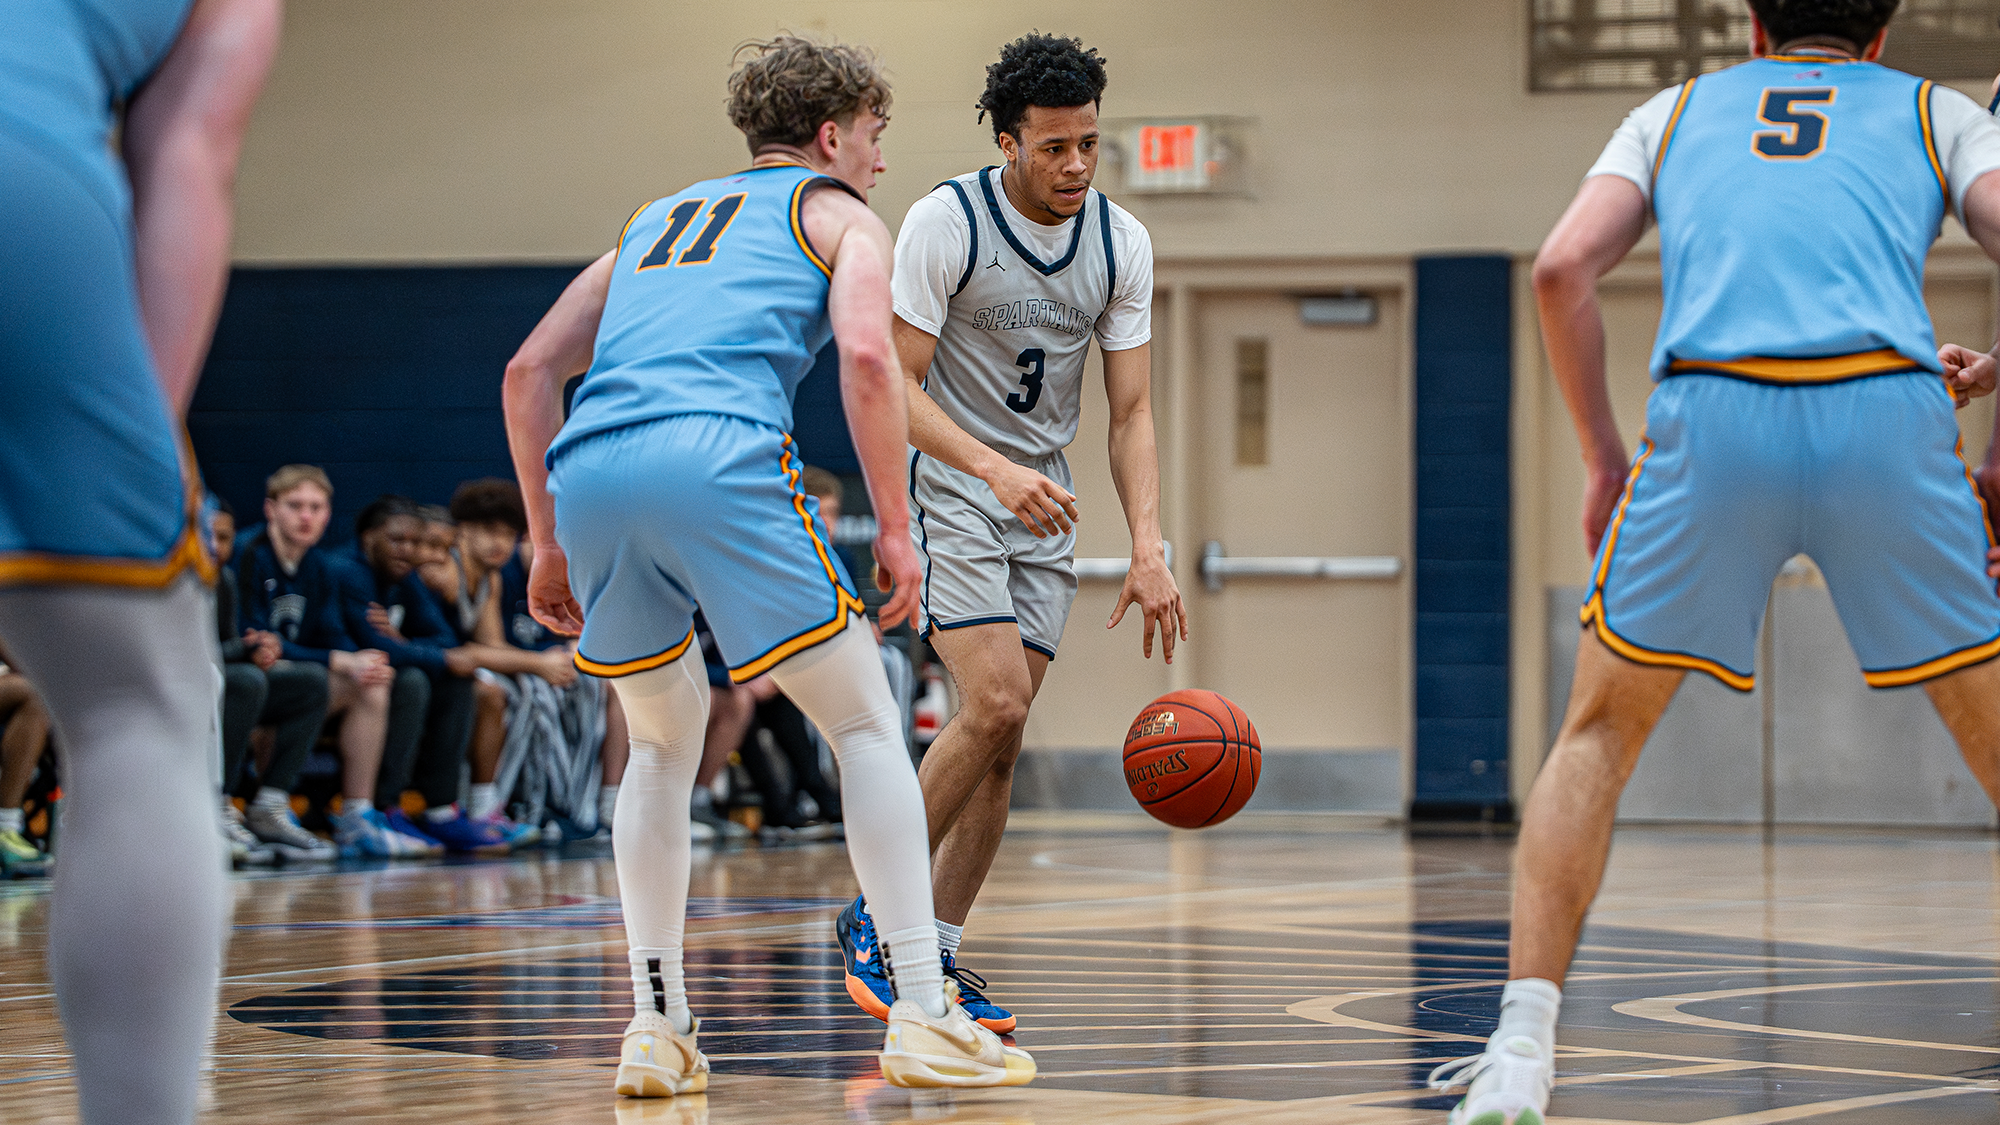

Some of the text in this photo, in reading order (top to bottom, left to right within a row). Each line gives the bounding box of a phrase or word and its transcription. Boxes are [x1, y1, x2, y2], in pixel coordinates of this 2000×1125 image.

[1751, 86, 1838, 162] 5
[635, 192, 748, 273] 11
[972, 298, 1092, 339] SPARTANS
[1005, 348, 1046, 413] 3
[1125, 749, 1189, 788] SPALDIN
